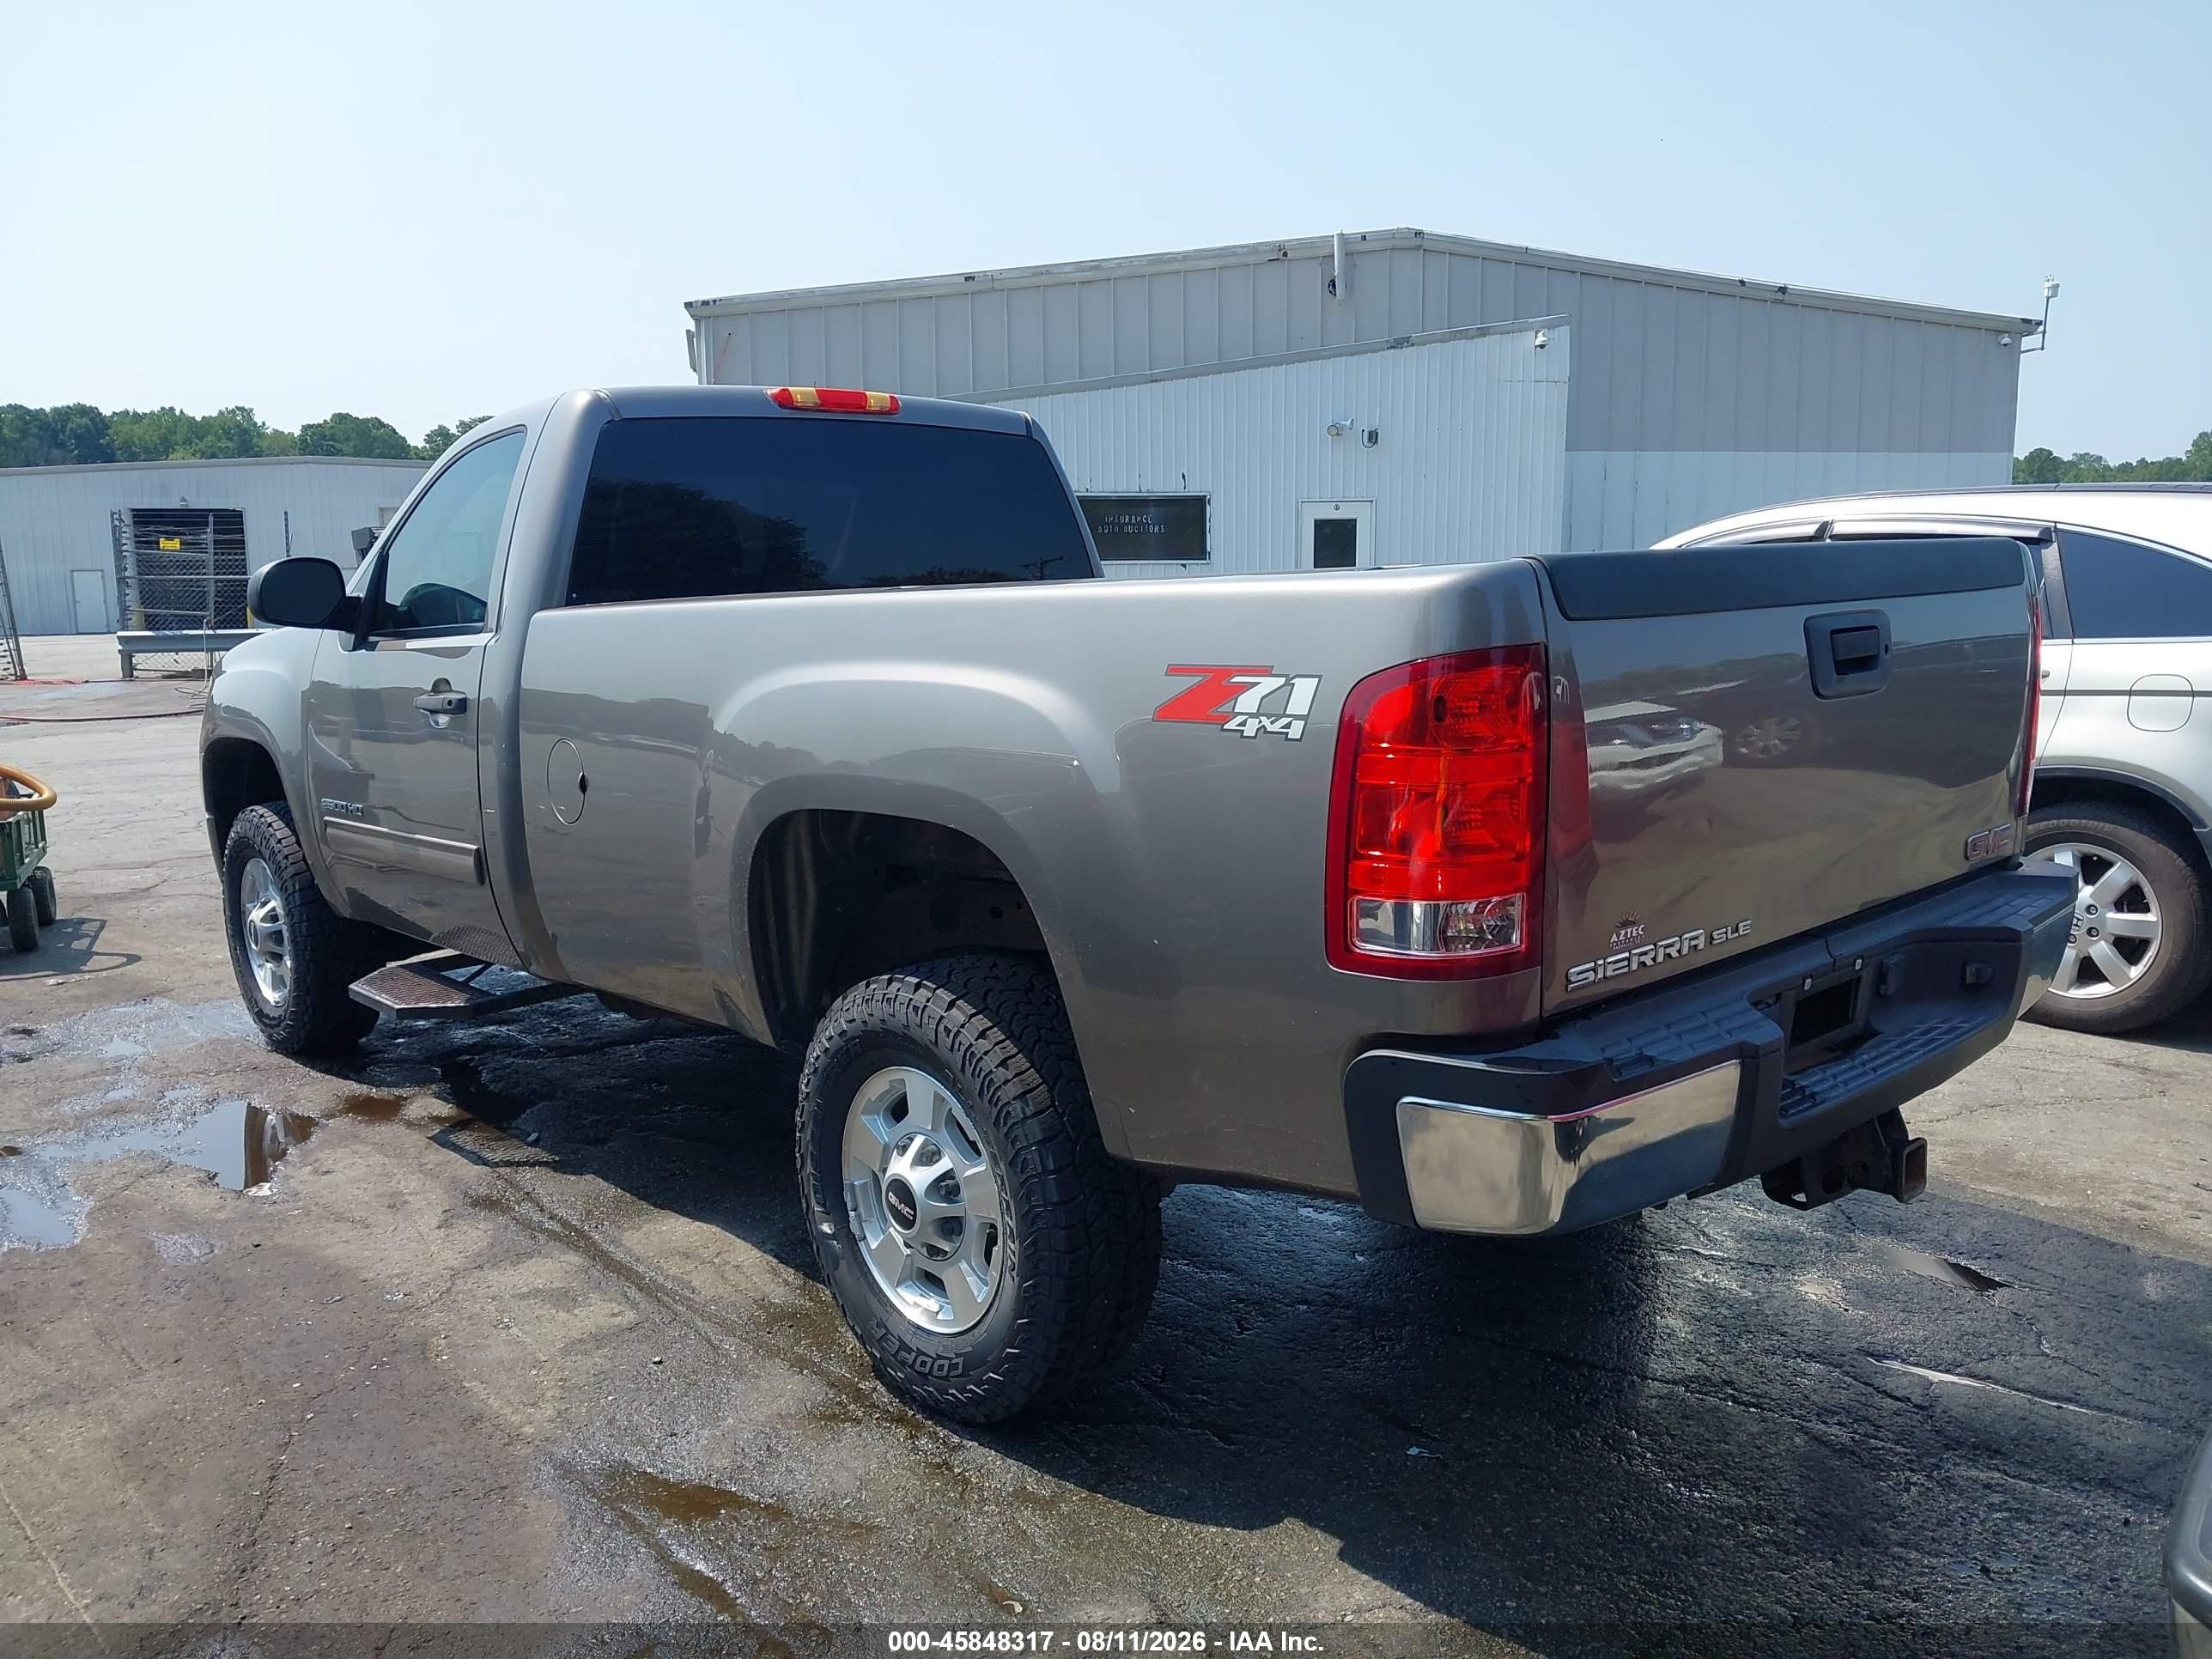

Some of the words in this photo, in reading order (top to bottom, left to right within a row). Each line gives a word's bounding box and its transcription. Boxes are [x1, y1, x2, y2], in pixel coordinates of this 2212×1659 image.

[1105, 514, 1152, 524] INSURANCE
[1123, 524, 1165, 533] AUCTIONS
[1152, 664, 1323, 725] Z71
[1609, 924, 1646, 943] AZTEC
[1566, 929, 1706, 993] SIERRA
[1711, 920, 1753, 945] SLE
[888, 1191, 915, 1220] GMC
[870, 1317, 963, 1377] COOPER
